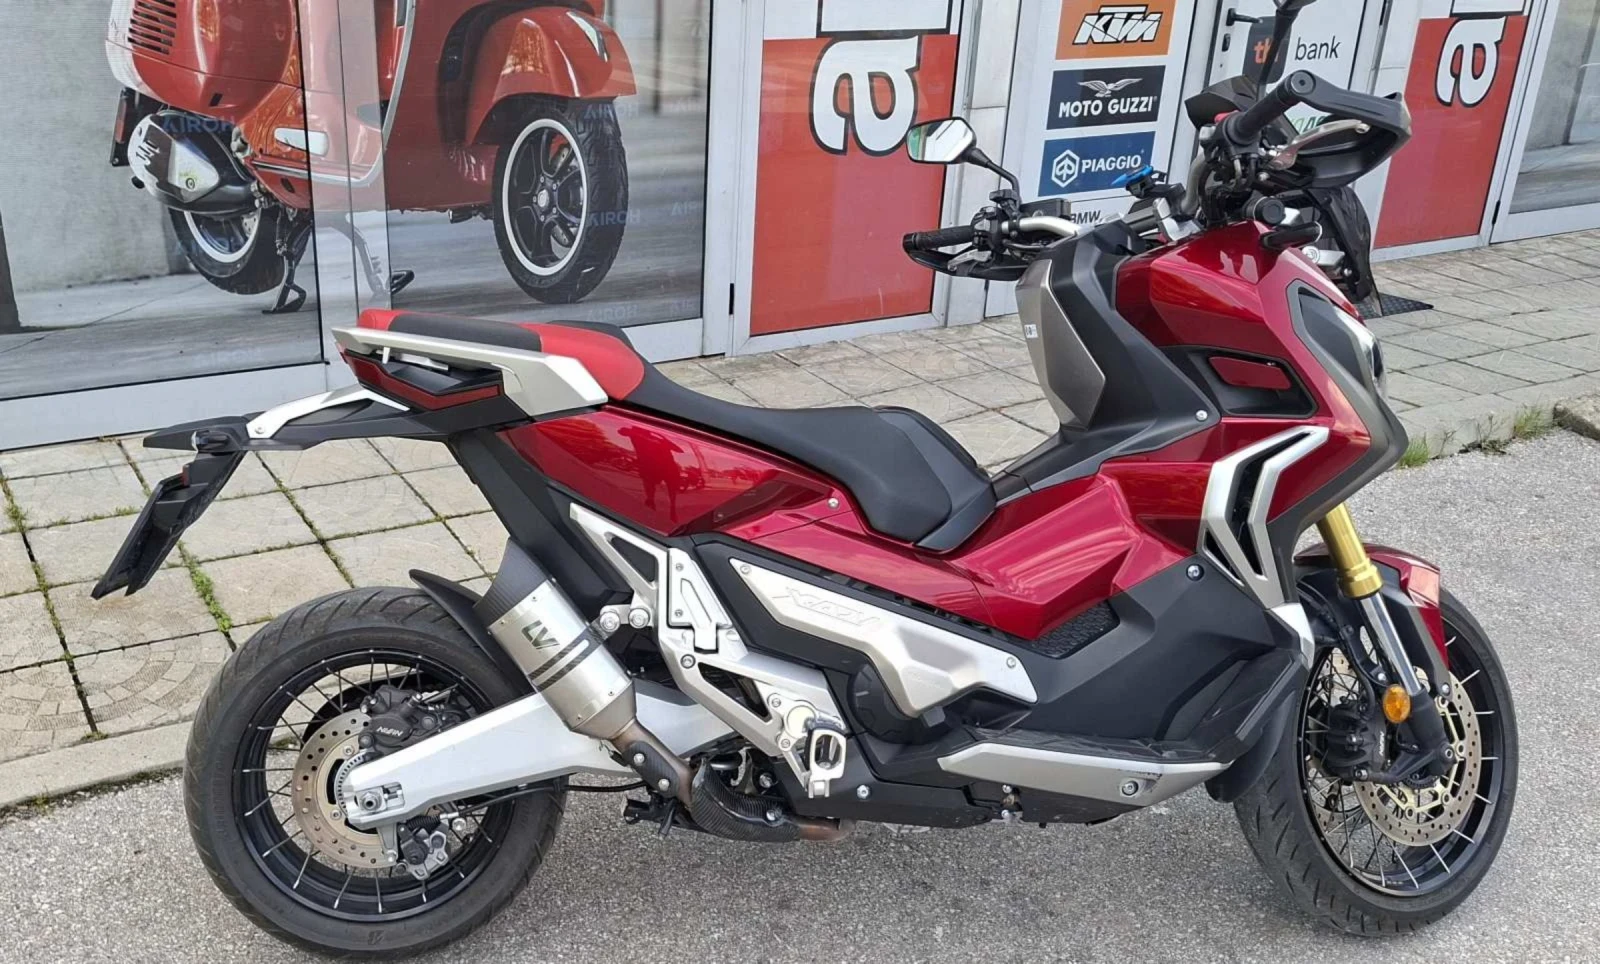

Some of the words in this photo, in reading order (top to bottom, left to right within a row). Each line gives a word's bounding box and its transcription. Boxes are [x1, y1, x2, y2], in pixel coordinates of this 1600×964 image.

[1072, 5, 1163, 45] KTM
[1294, 35, 1341, 61] bank
[1059, 100, 1103, 118] MOTO
[1107, 96, 1154, 115] GUZZI
[1081, 155, 1142, 173] PIAGGIO
